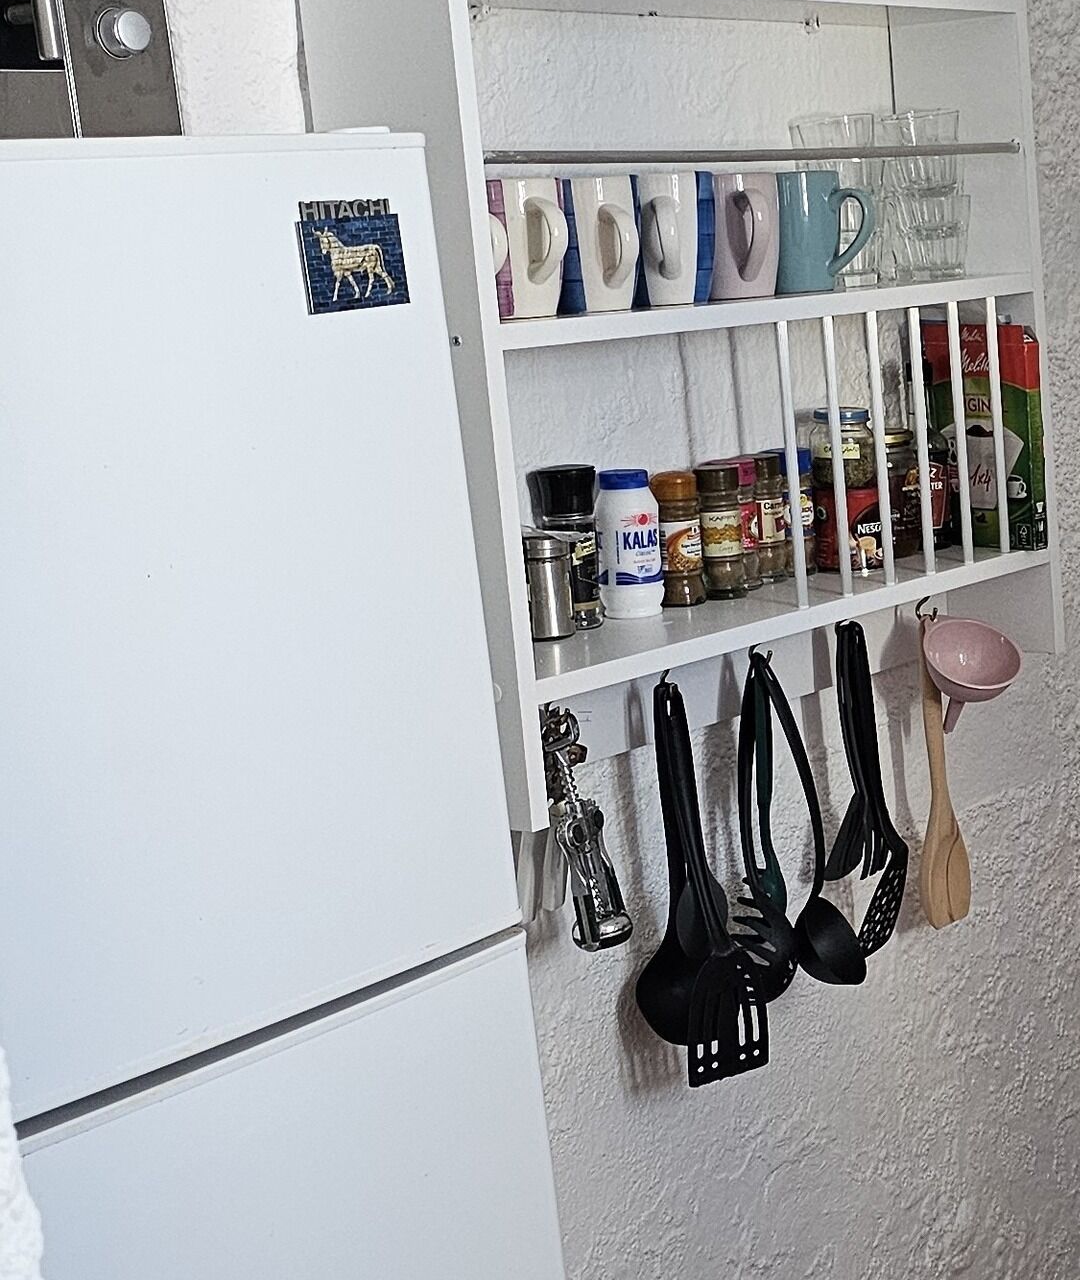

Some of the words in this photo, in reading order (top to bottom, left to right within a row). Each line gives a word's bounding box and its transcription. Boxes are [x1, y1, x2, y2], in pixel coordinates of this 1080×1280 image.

[299, 199, 391, 221] HITACHI
[969, 464, 992, 492] 1x4
[623, 528, 658, 550] KALAS
